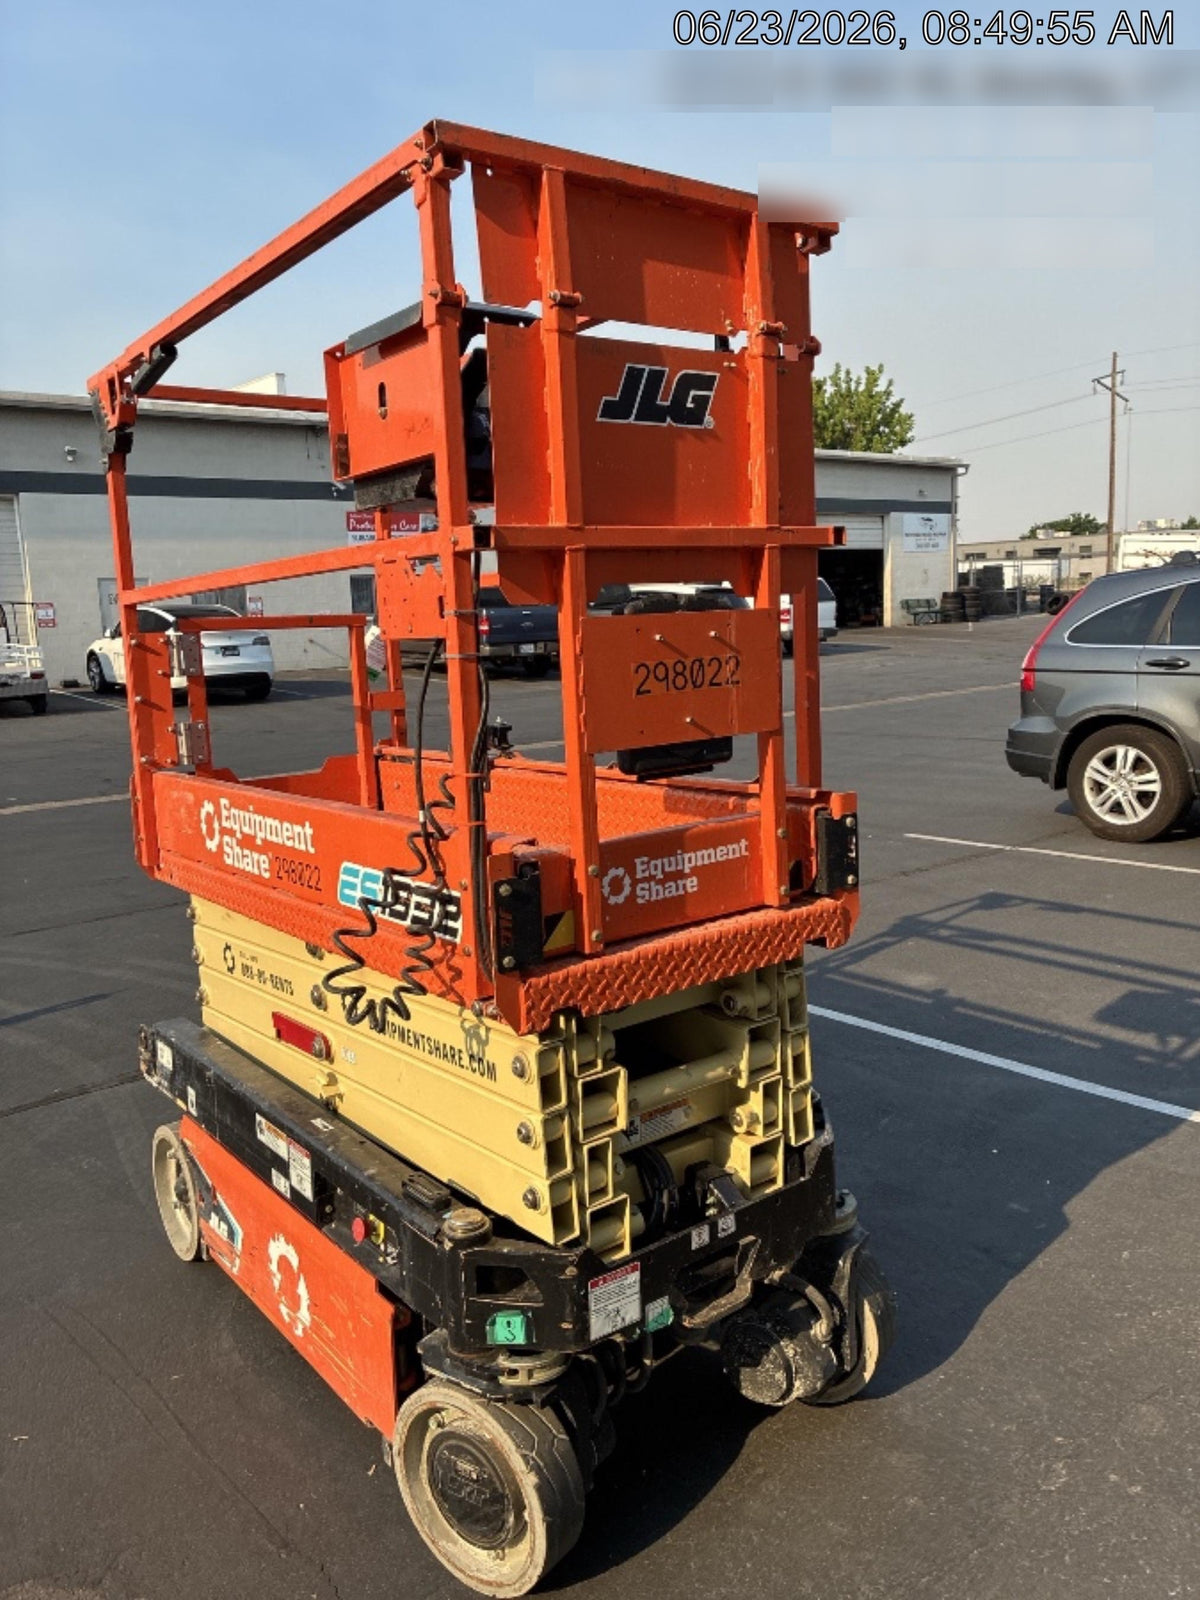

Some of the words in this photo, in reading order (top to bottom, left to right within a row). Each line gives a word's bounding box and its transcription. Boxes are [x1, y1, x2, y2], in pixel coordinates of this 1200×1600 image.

[596, 363, 720, 428] JLG
[635, 655, 740, 695] 298022
[219, 797, 316, 854] Equipment
[222, 834, 271, 879] Share
[274, 855, 323, 892] 298022
[634, 838, 749, 880] Equipment
[635, 875, 698, 904] Share
[369, 1012, 498, 1083] IPMENTSHARE.COM
